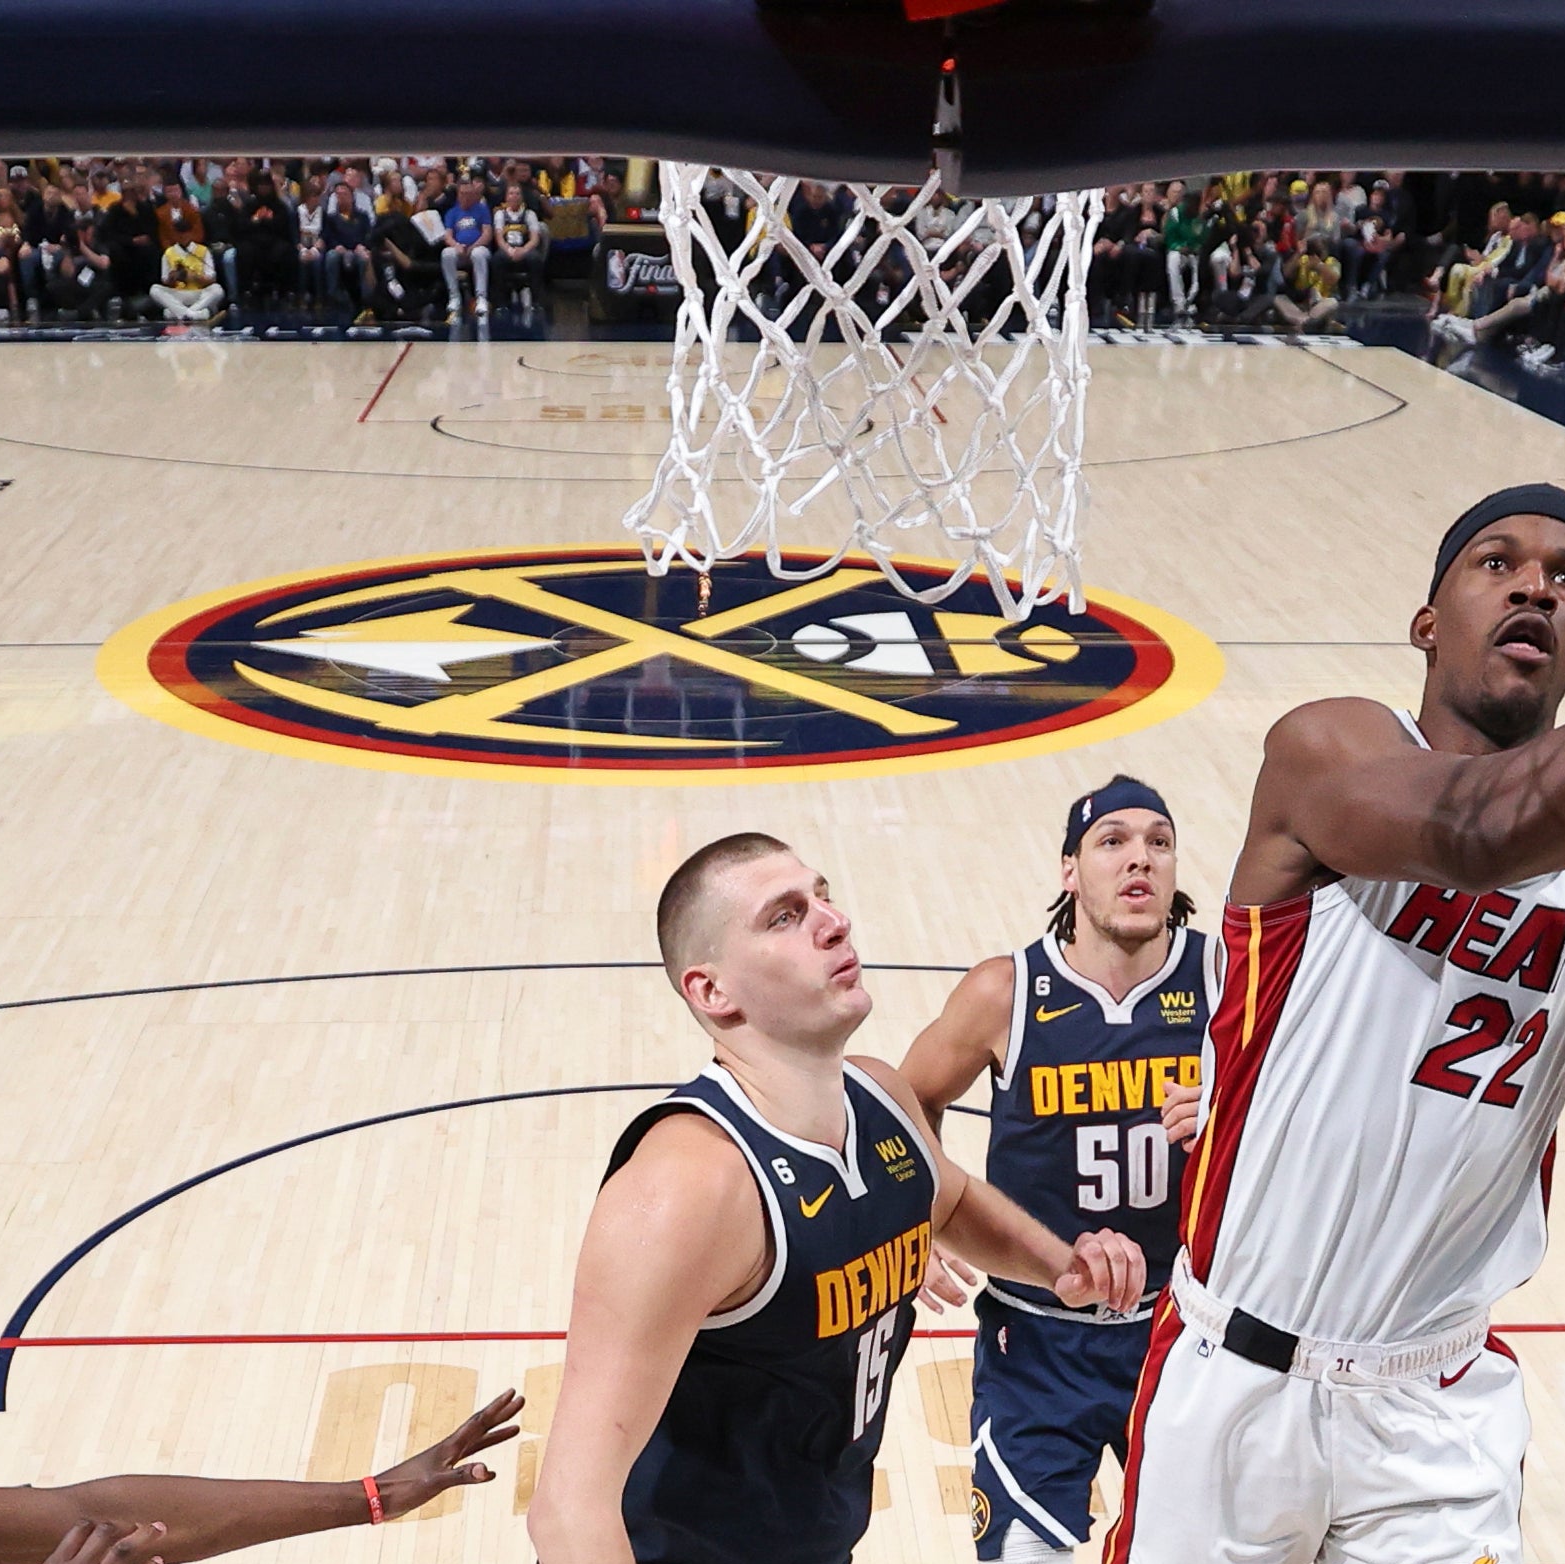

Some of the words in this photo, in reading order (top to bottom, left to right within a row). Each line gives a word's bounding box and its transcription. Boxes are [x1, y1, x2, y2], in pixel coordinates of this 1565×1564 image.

[1035, 975, 1052, 996] 6
[1159, 991, 1196, 1010] WU
[1160, 1008, 1197, 1019] Western
[1167, 1014, 1193, 1025] Union
[1410, 992, 1550, 1110] 22
[875, 1135, 908, 1163] WU
[771, 1156, 797, 1185] 6
[1076, 1123, 1170, 1213] 50
[814, 1219, 932, 1340] DENVER
[852, 1304, 900, 1443] 15
